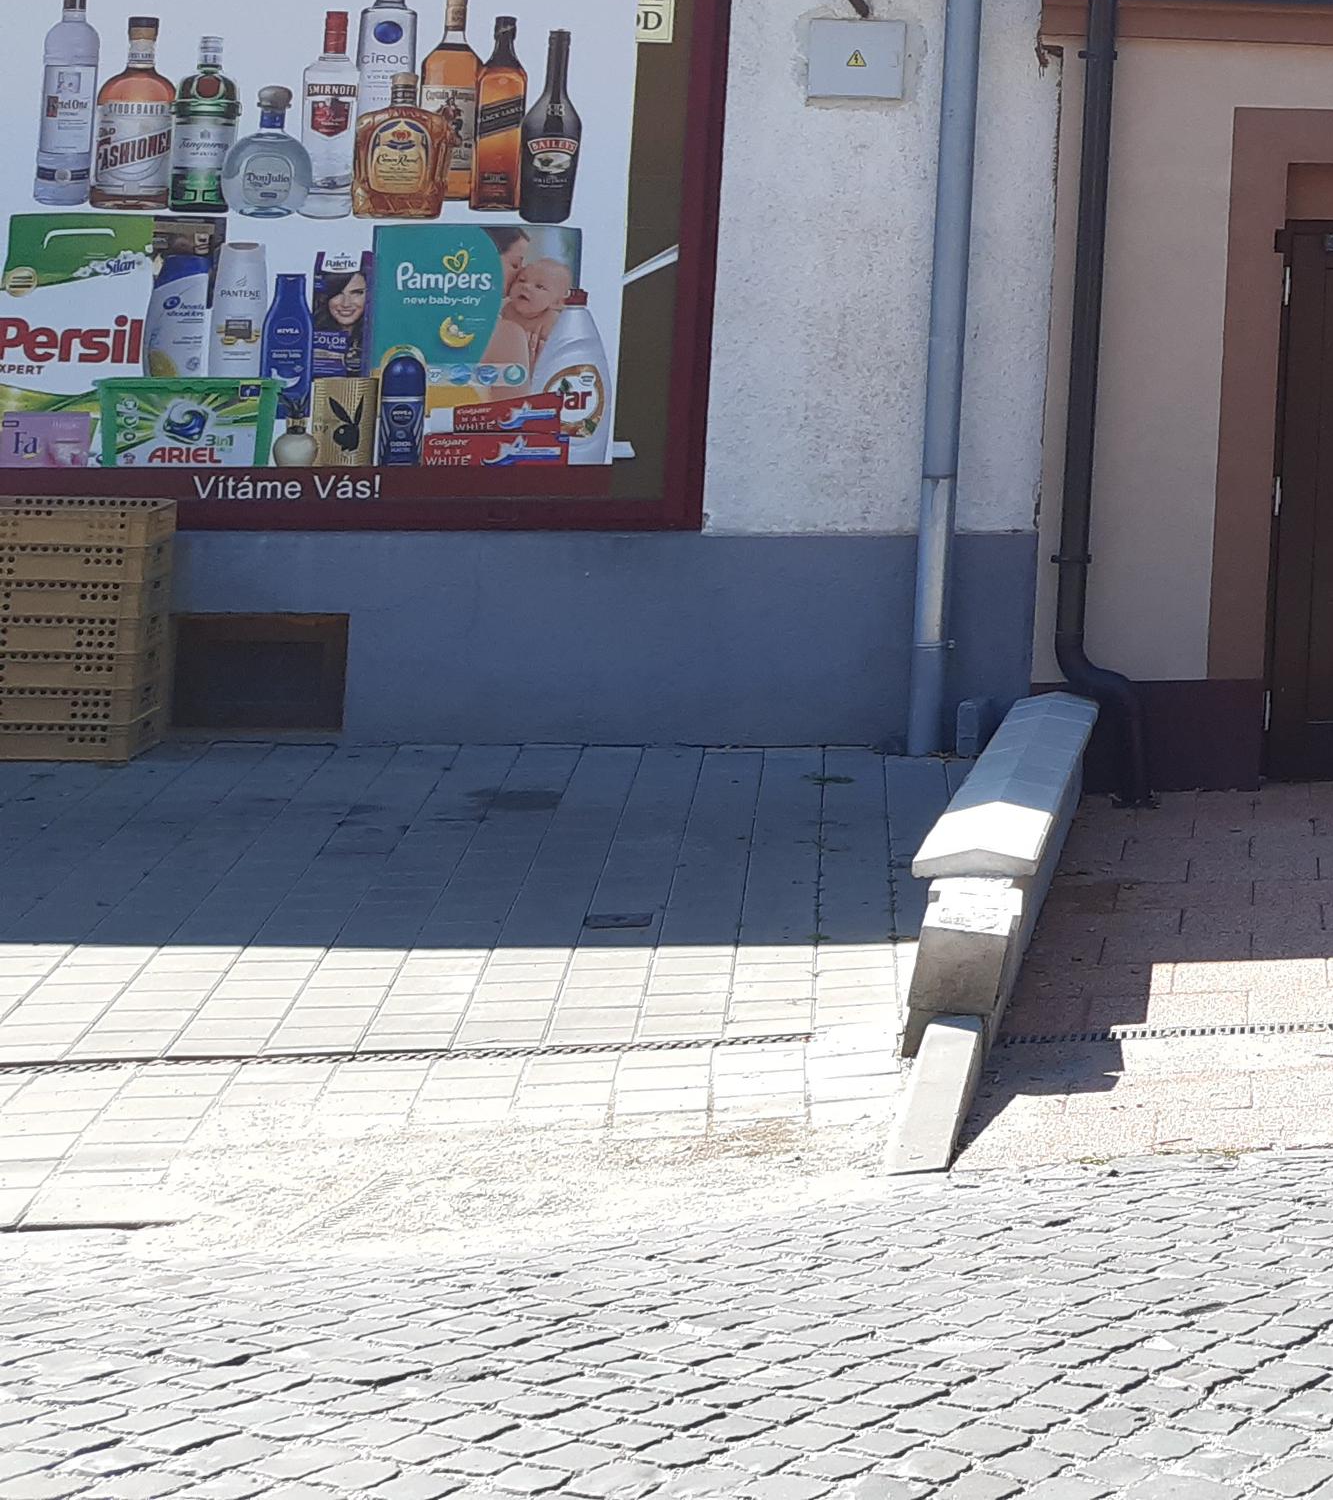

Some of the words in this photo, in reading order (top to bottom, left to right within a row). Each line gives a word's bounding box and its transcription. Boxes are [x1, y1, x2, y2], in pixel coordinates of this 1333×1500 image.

[636, 11, 662, 30] D
[309, 85, 357, 95] SMIRNOFF
[103, 259, 136, 275] Silan
[396, 262, 492, 293] Pampers
[220, 289, 260, 298] PANTENE
[403, 296, 427, 304] new
[0, 315, 144, 364] Persil
[455, 422, 495, 430] WHITE
[13, 431, 38, 454] Fa
[429, 438, 470, 448] Colgate
[148, 447, 222, 464] ARIEL
[425, 457, 470, 466] WHITE
[193, 474, 301, 499] Vítáme
[314, 474, 381, 499] Vás!
